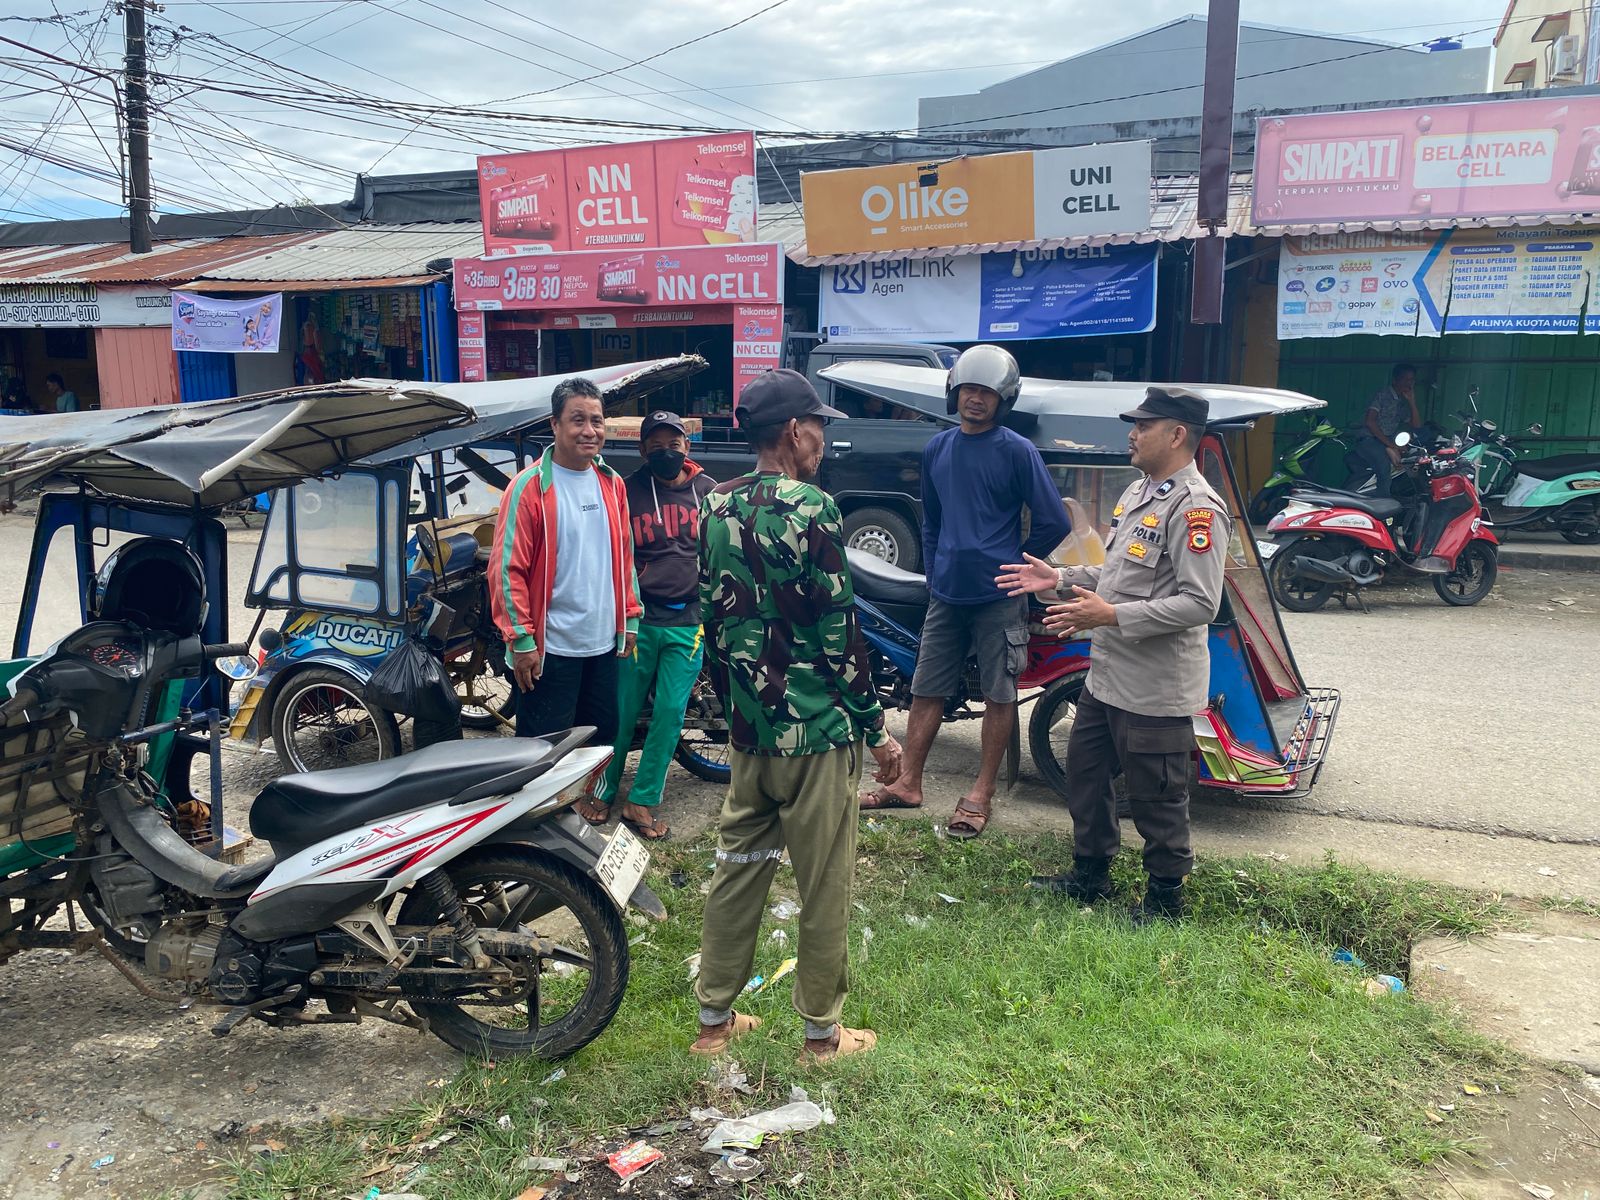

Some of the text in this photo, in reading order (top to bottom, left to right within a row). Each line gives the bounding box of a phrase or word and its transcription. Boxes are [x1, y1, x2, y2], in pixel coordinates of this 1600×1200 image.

[697, 140, 746, 154] Telkomsel
[1422, 141, 1547, 161] BELANTARA
[1283, 139, 1398, 181] SIMPATI
[1070, 166, 1111, 186] UNI
[1457, 161, 1505, 178] CELL
[588, 163, 632, 194] NN
[686, 173, 727, 187] Telkomsel
[1278, 184, 1399, 195] TERBAIK UNTUKMU
[498, 194, 538, 218] SIMPATI
[684, 192, 724, 206] Telkomsel
[1063, 194, 1120, 214] CELL
[577, 196, 649, 227] CELL
[682, 210, 722, 224] Telkomsel
[900, 222, 968, 233] Smart Accessories
[1496, 229, 1551, 239] Melayani
[725, 253, 768, 263] Telkomsel
[604, 269, 635, 287] SIMPATI
[1383, 280, 1408, 288] OVO
[541, 276, 561, 299] 30
[658, 272, 768, 300] NN CELL
[872, 282, 904, 296] Agen
[739, 307, 777, 316] Telkomsel
[1348, 301, 1376, 310] gopay
[13, 306, 30, 321] SOP
[32, 306, 72, 321] SAUDARA
[77, 305, 100, 321] COTO
[1375, 320, 1391, 328] BNI
[1470, 319, 1513, 327] AHLINYA
[1516, 318, 1550, 327] KUOTA
[736, 345, 778, 354] NN CELL
[1132, 526, 1161, 543] POLRI
[318, 621, 400, 648] DUCATI
